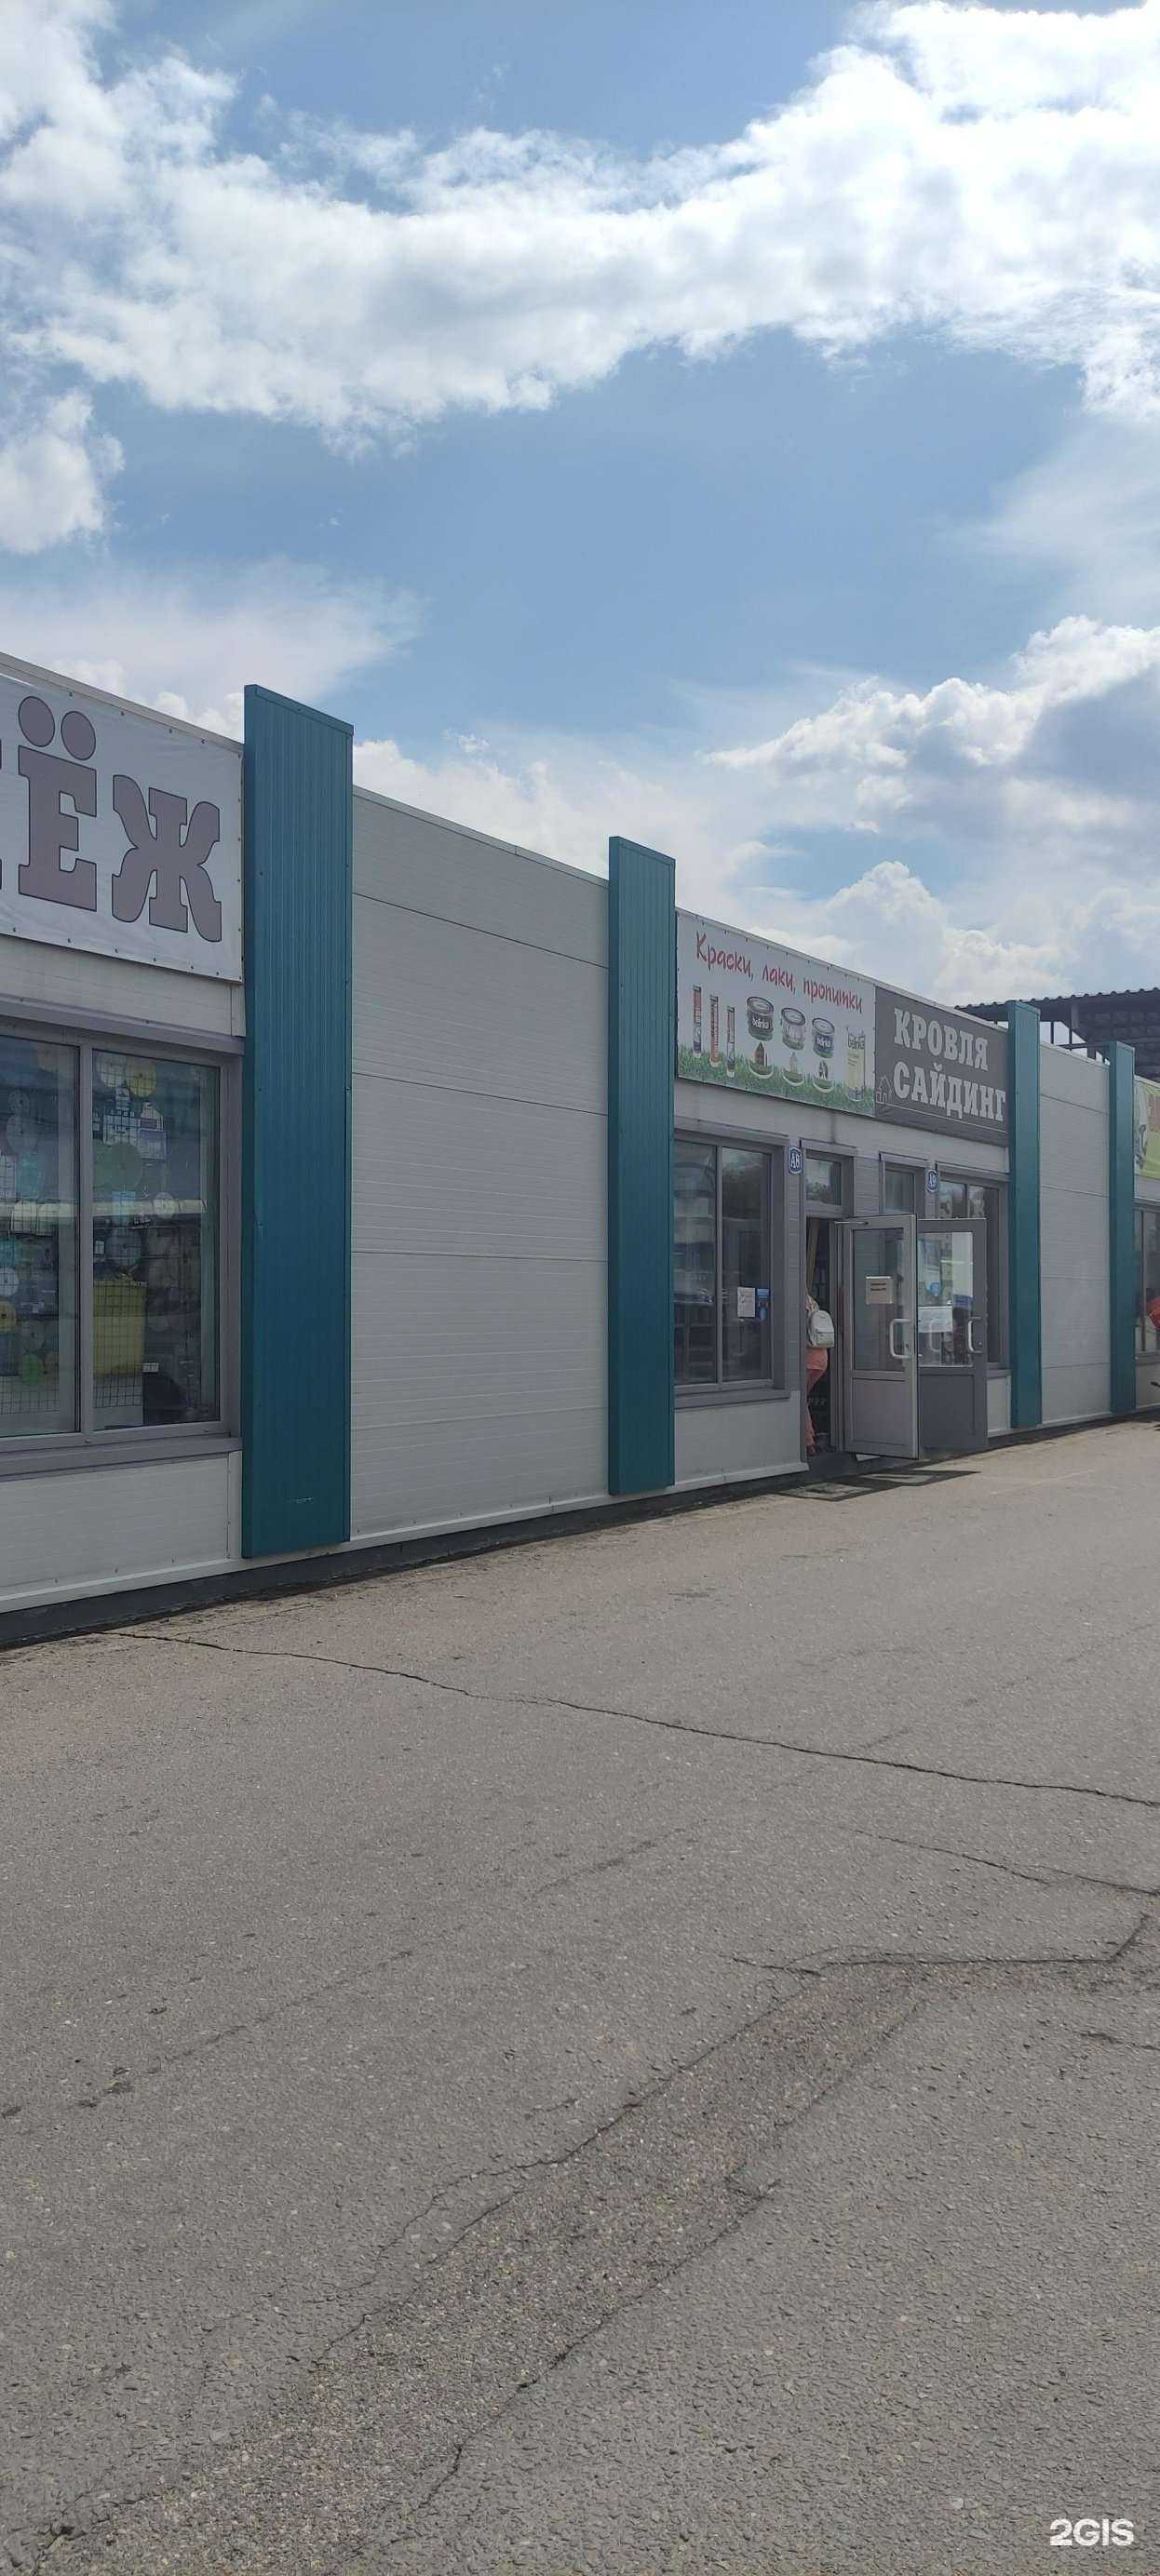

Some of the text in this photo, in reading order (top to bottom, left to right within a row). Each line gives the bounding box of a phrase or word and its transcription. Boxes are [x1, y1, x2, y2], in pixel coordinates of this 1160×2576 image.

[0, 695, 223, 942] ЁЖ
[695, 931, 863, 1013] Краски, лаки, пропитки
[894, 1008, 989, 1071] КРОВЛЯ
[893, 1061, 1006, 1121] САЙДИНГ
